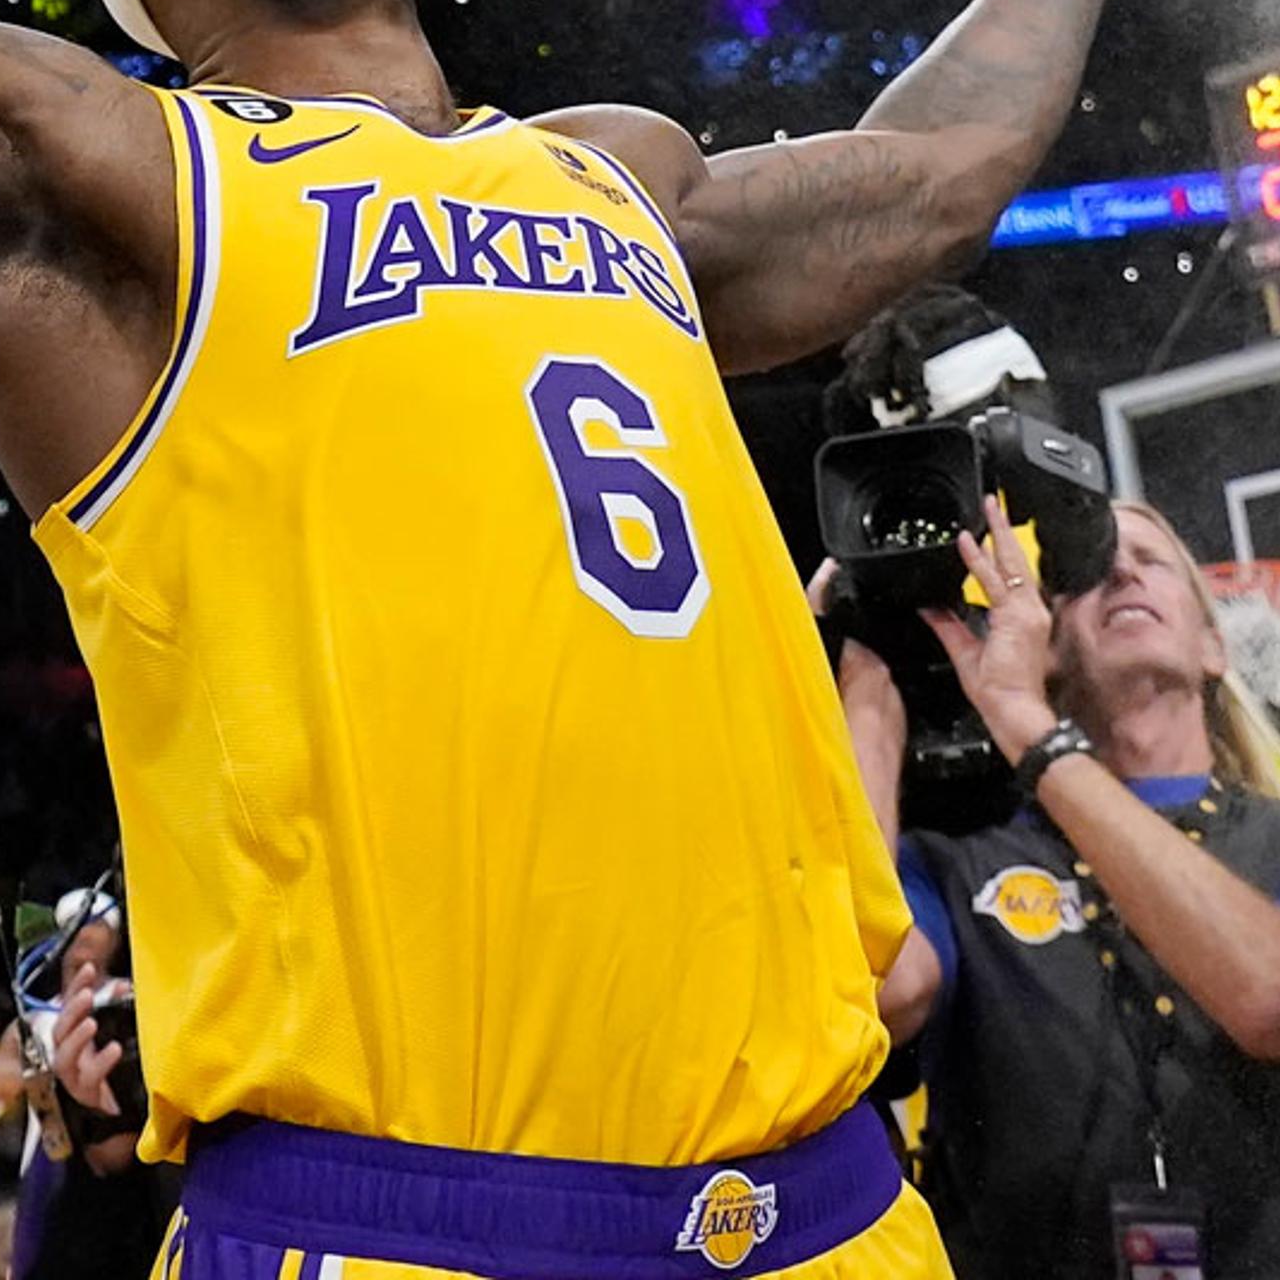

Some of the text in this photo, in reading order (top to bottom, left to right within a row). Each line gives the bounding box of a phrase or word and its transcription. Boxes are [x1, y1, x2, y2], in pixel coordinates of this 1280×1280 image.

[286, 178, 703, 358] LAKERS
[524, 354, 711, 639] 6
[678, 1197, 778, 1248] LAKERS
